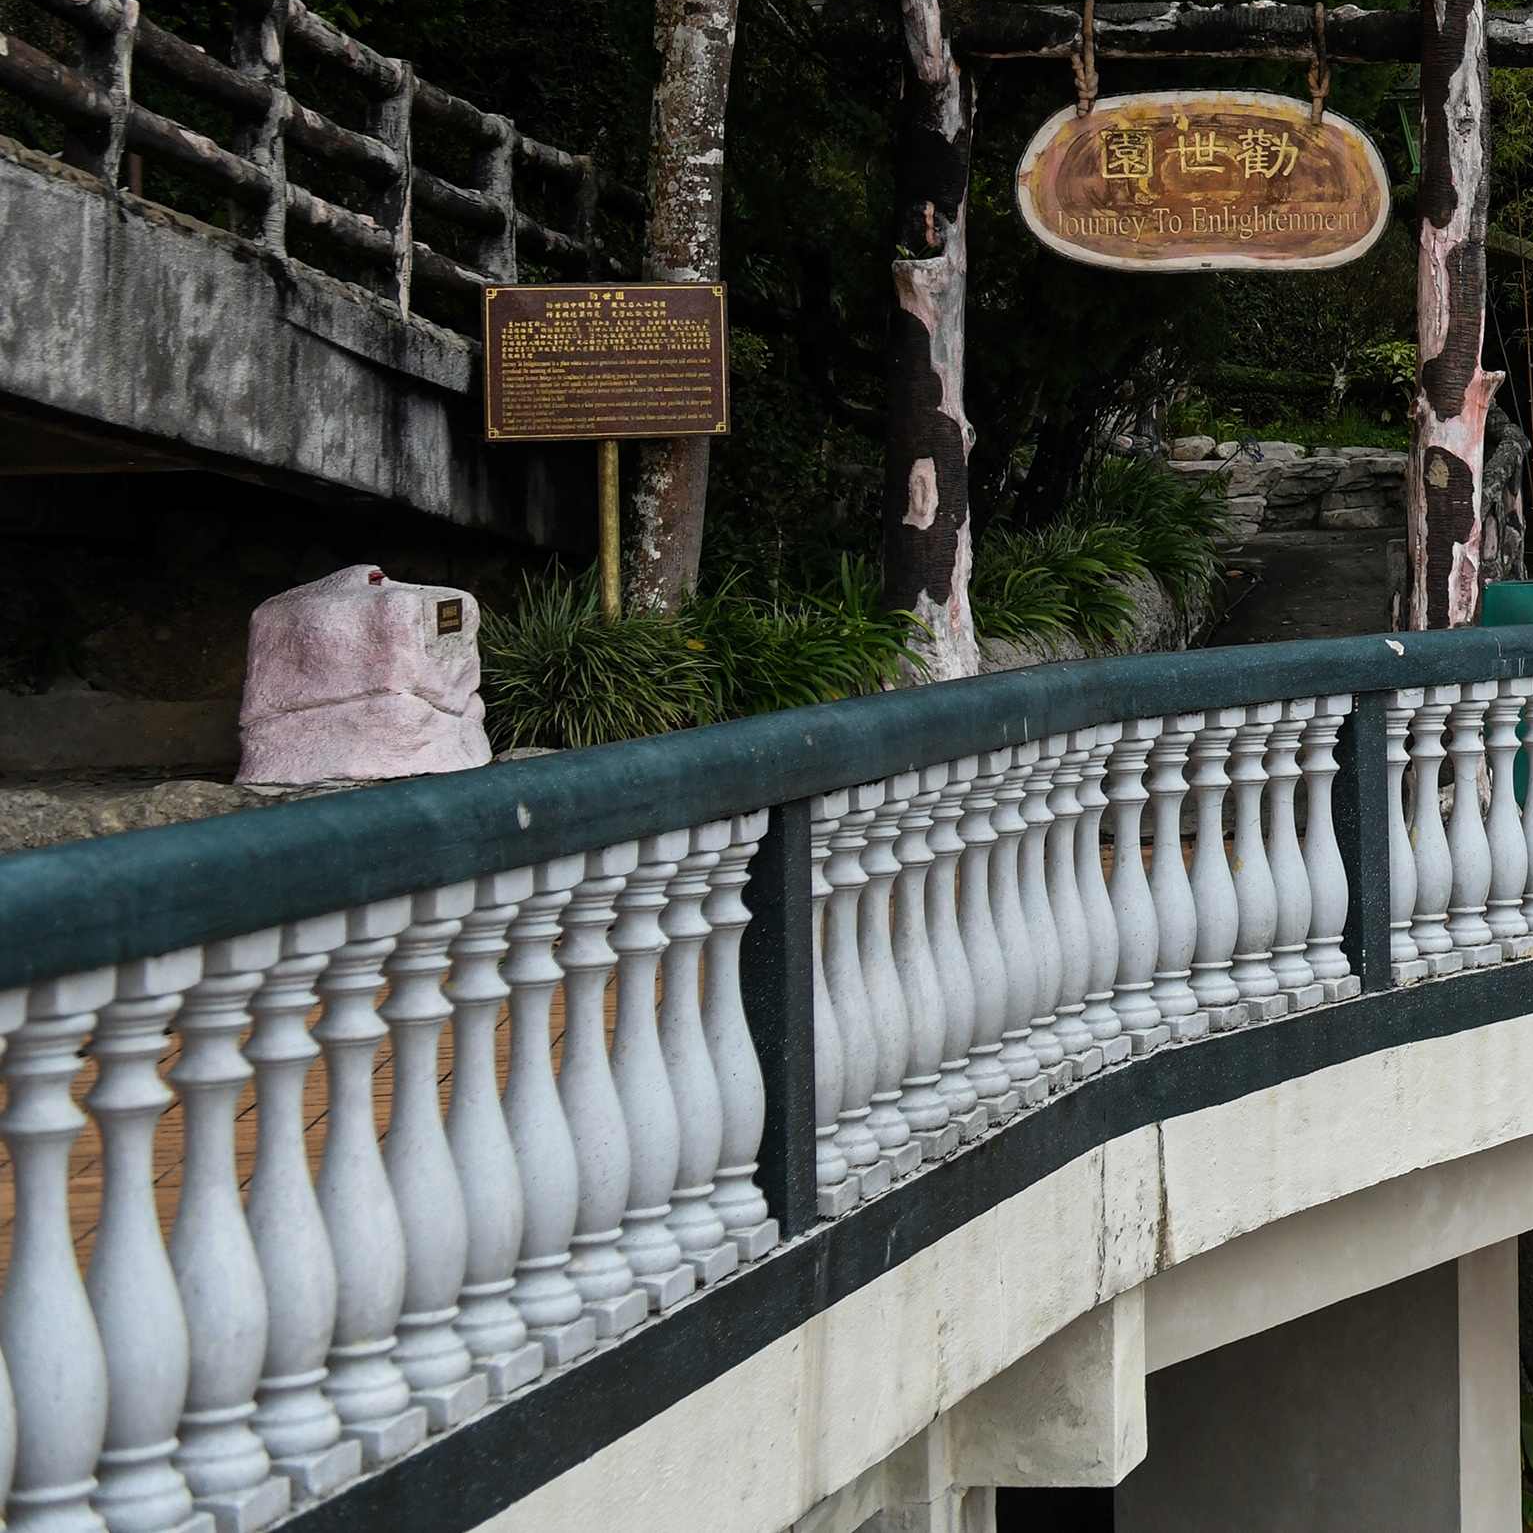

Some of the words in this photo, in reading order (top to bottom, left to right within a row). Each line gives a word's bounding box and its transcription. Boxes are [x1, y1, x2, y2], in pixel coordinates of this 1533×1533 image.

[1055, 209, 1146, 242] Journey
[1152, 207, 1182, 233] To
[1191, 205, 1360, 239] Enlightenment
